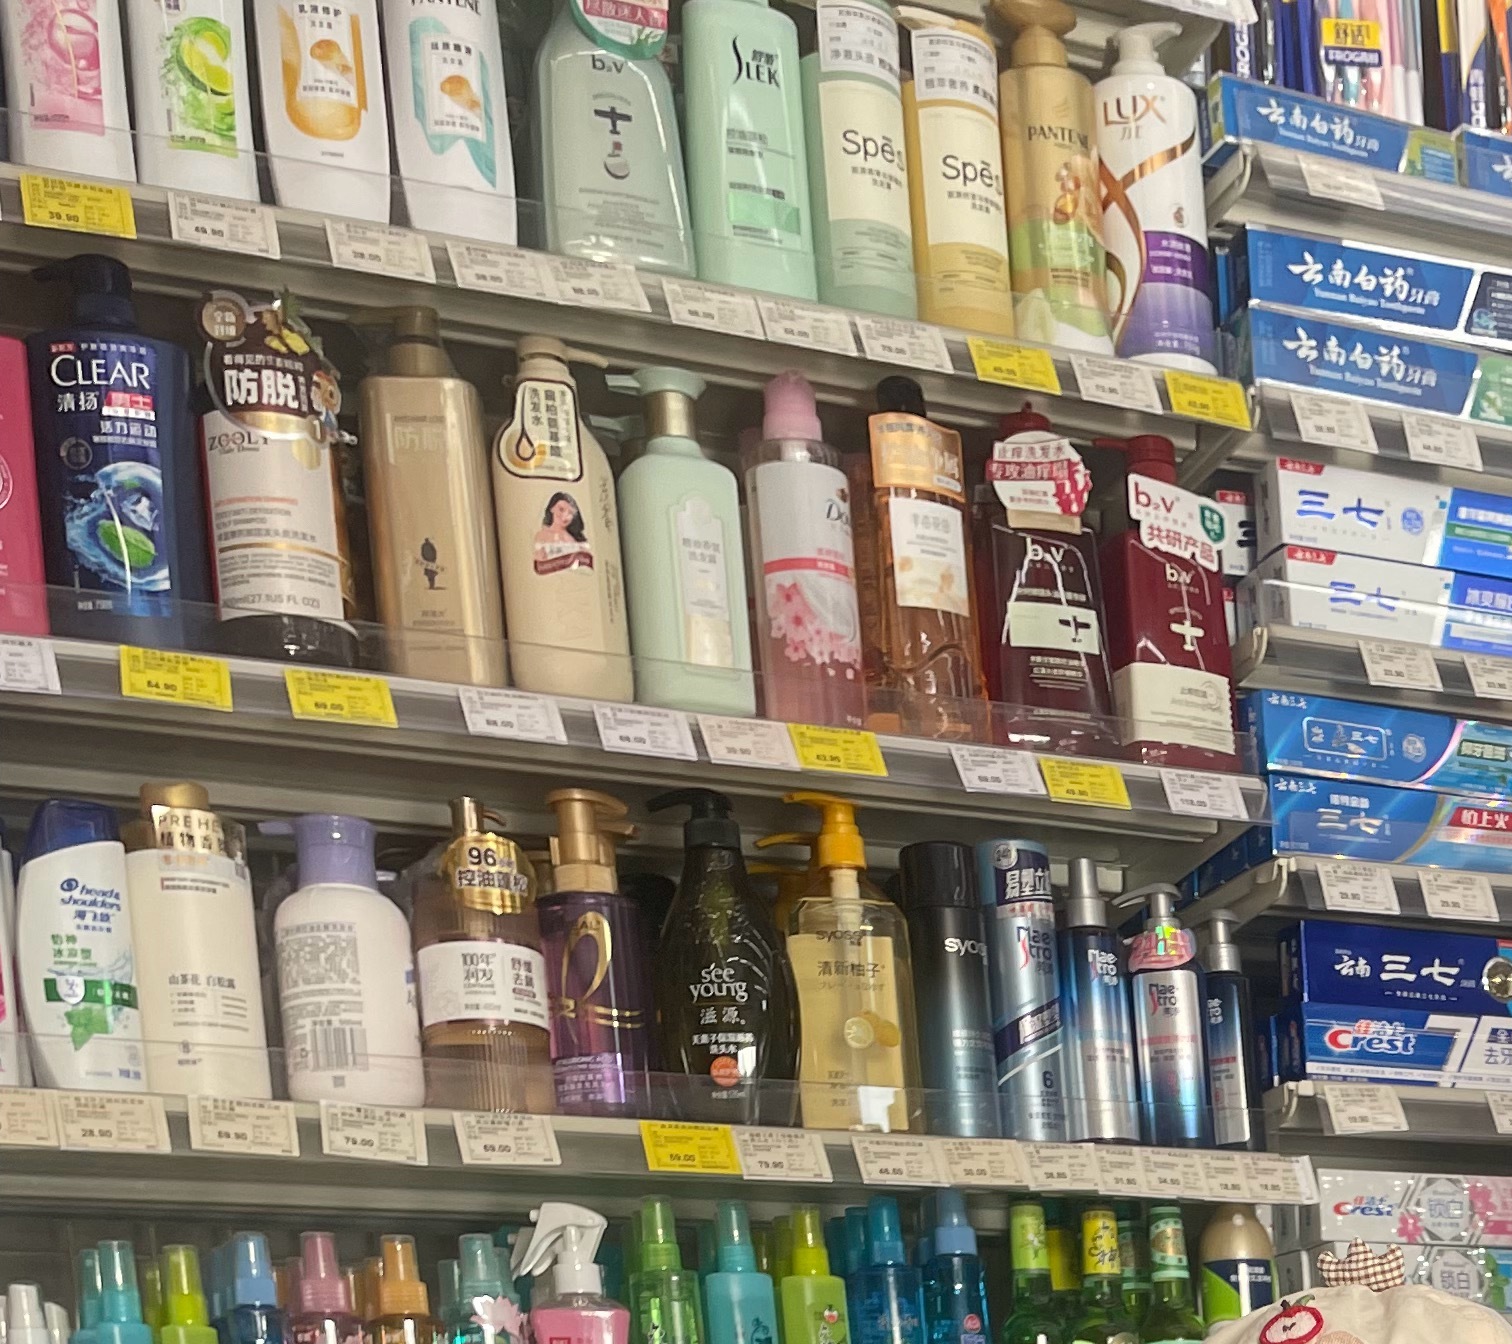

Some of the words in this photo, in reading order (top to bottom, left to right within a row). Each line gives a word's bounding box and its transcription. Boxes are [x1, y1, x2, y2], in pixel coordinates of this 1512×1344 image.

[1104, 95, 1164, 127] LUX
[1256, 97, 1381, 153] 云南白药牙膏
[1287, 250, 1442, 307] 云南白药牙膏
[51, 354, 150, 390] CLEAR
[1282, 328, 1438, 388] 云南白药牙膏
[56, 391, 98, 413] 清扬
[1296, 488, 1385, 528] 三七
[701, 963, 735, 983] see
[817, 959, 882, 979] 清新柚子
[688, 980, 748, 1004] young
[1325, 1027, 1416, 1056] Crest
